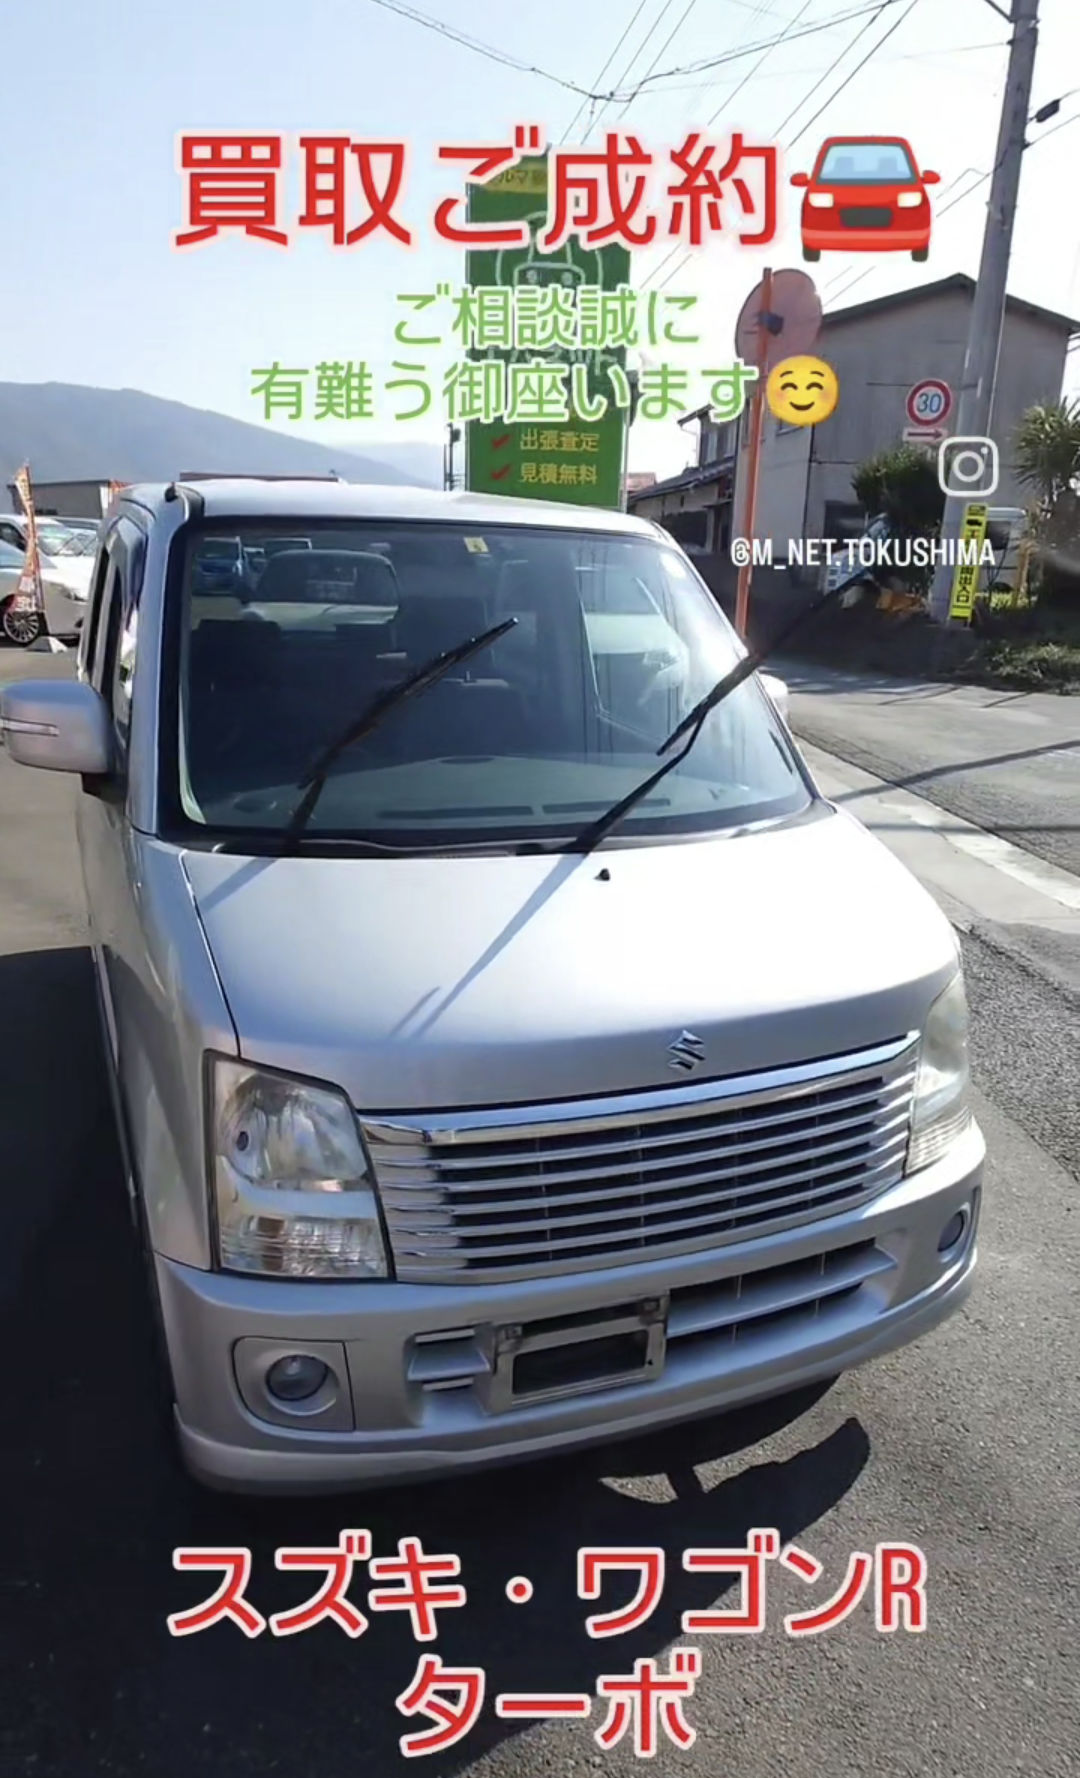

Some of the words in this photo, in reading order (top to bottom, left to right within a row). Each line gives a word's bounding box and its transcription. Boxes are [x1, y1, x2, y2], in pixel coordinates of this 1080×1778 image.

[917, 392, 942, 413] 30
[520, 428, 600, 452] 出張査定
[520, 461, 598, 485] 見積無料
